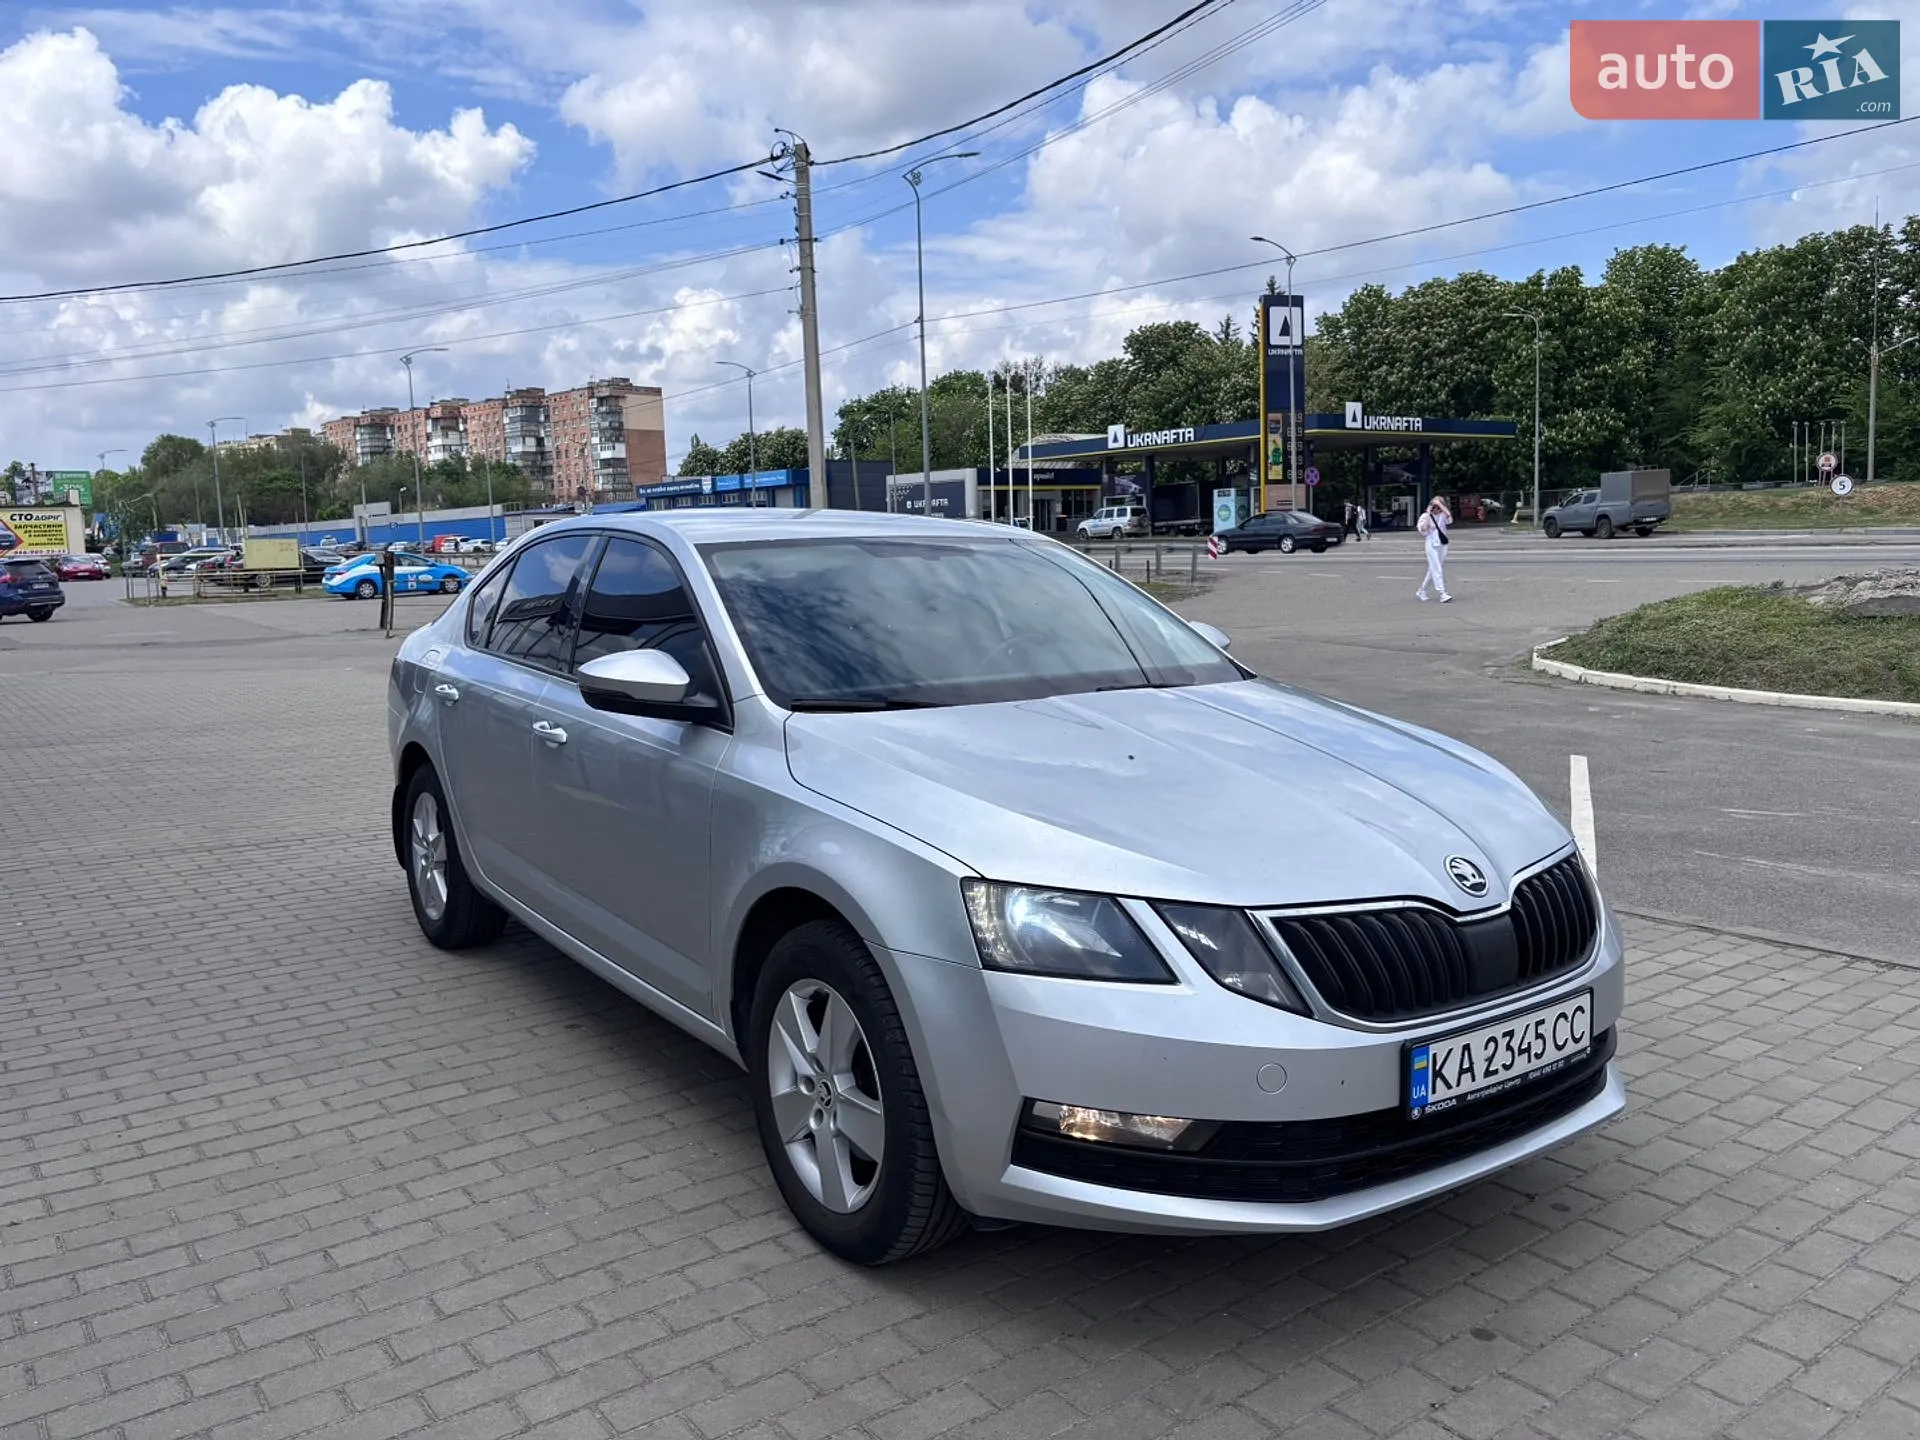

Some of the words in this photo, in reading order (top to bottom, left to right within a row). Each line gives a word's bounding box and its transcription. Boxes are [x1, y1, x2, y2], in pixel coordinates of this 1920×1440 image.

[1364, 415, 1423, 432] UKRNAFTA
[1127, 427, 1195, 448] UKRNAFTA
[1838, 480, 1846, 491] 5
[1431, 1042, 1476, 1095] KA
[1483, 1018, 1547, 1079] 2345
[1552, 1005, 1586, 1051] CC
[1412, 1084, 1427, 1099] UA
